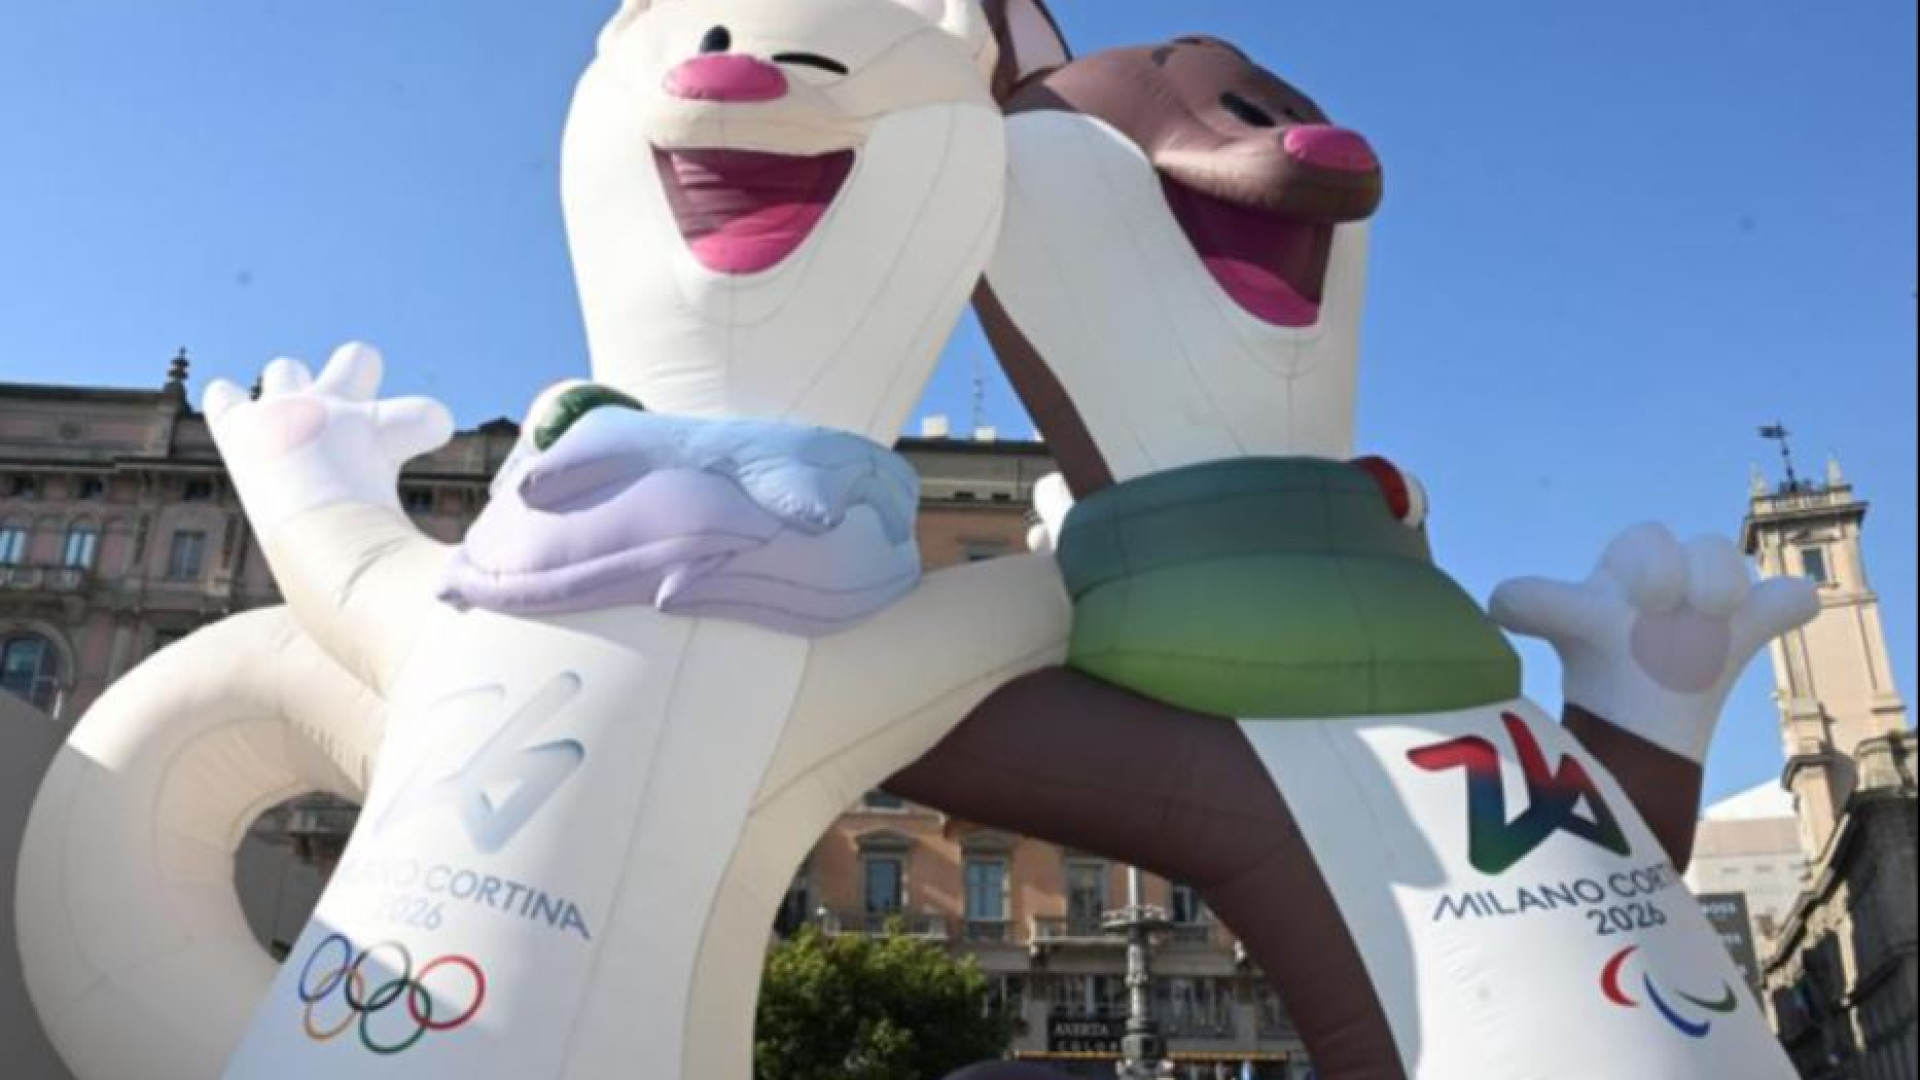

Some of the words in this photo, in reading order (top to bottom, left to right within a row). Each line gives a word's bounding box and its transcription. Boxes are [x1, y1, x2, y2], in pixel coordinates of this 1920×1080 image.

[426, 863, 593, 942] CORTINA
[1432, 878, 1605, 922] MILANO
[1586, 902, 1667, 936] 2026
